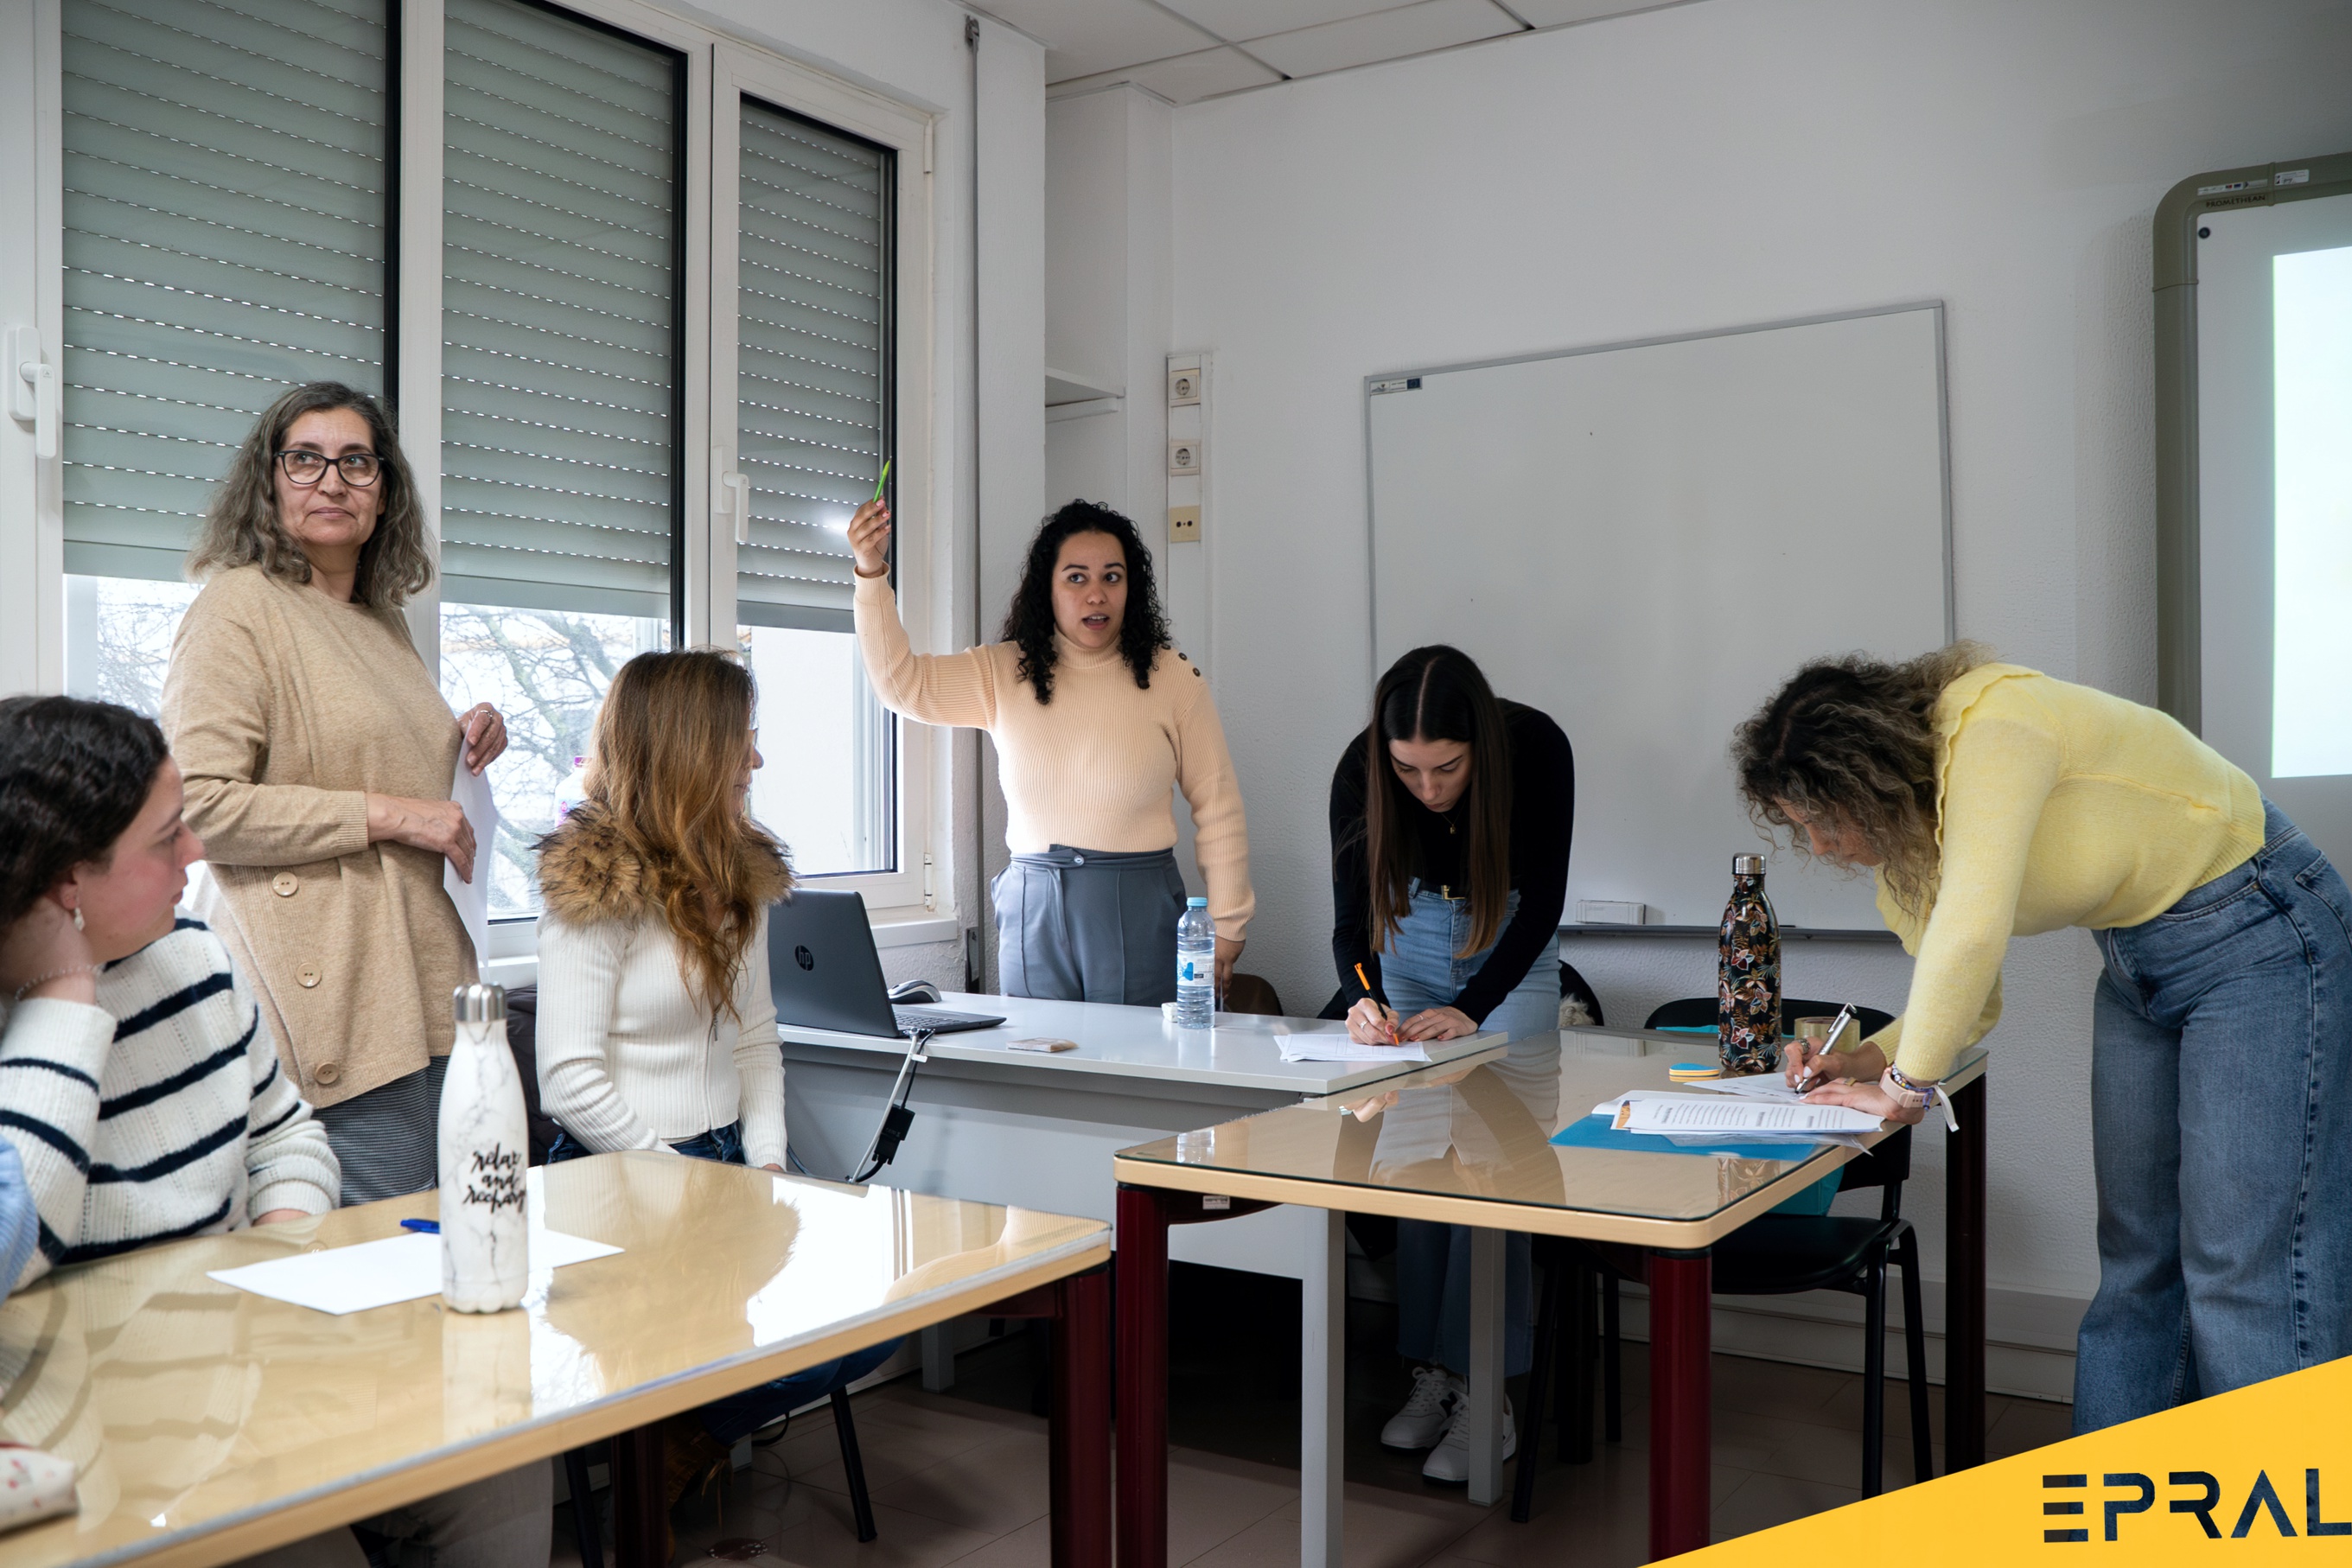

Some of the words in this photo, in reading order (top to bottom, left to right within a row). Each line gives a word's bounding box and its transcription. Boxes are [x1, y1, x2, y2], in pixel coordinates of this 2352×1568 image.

[2206, 194, 2266, 208] PROMETHEAN
[798, 945, 812, 971] hp
[481, 1168, 519, 1189] and
[462, 1184, 526, 1214] recharg
